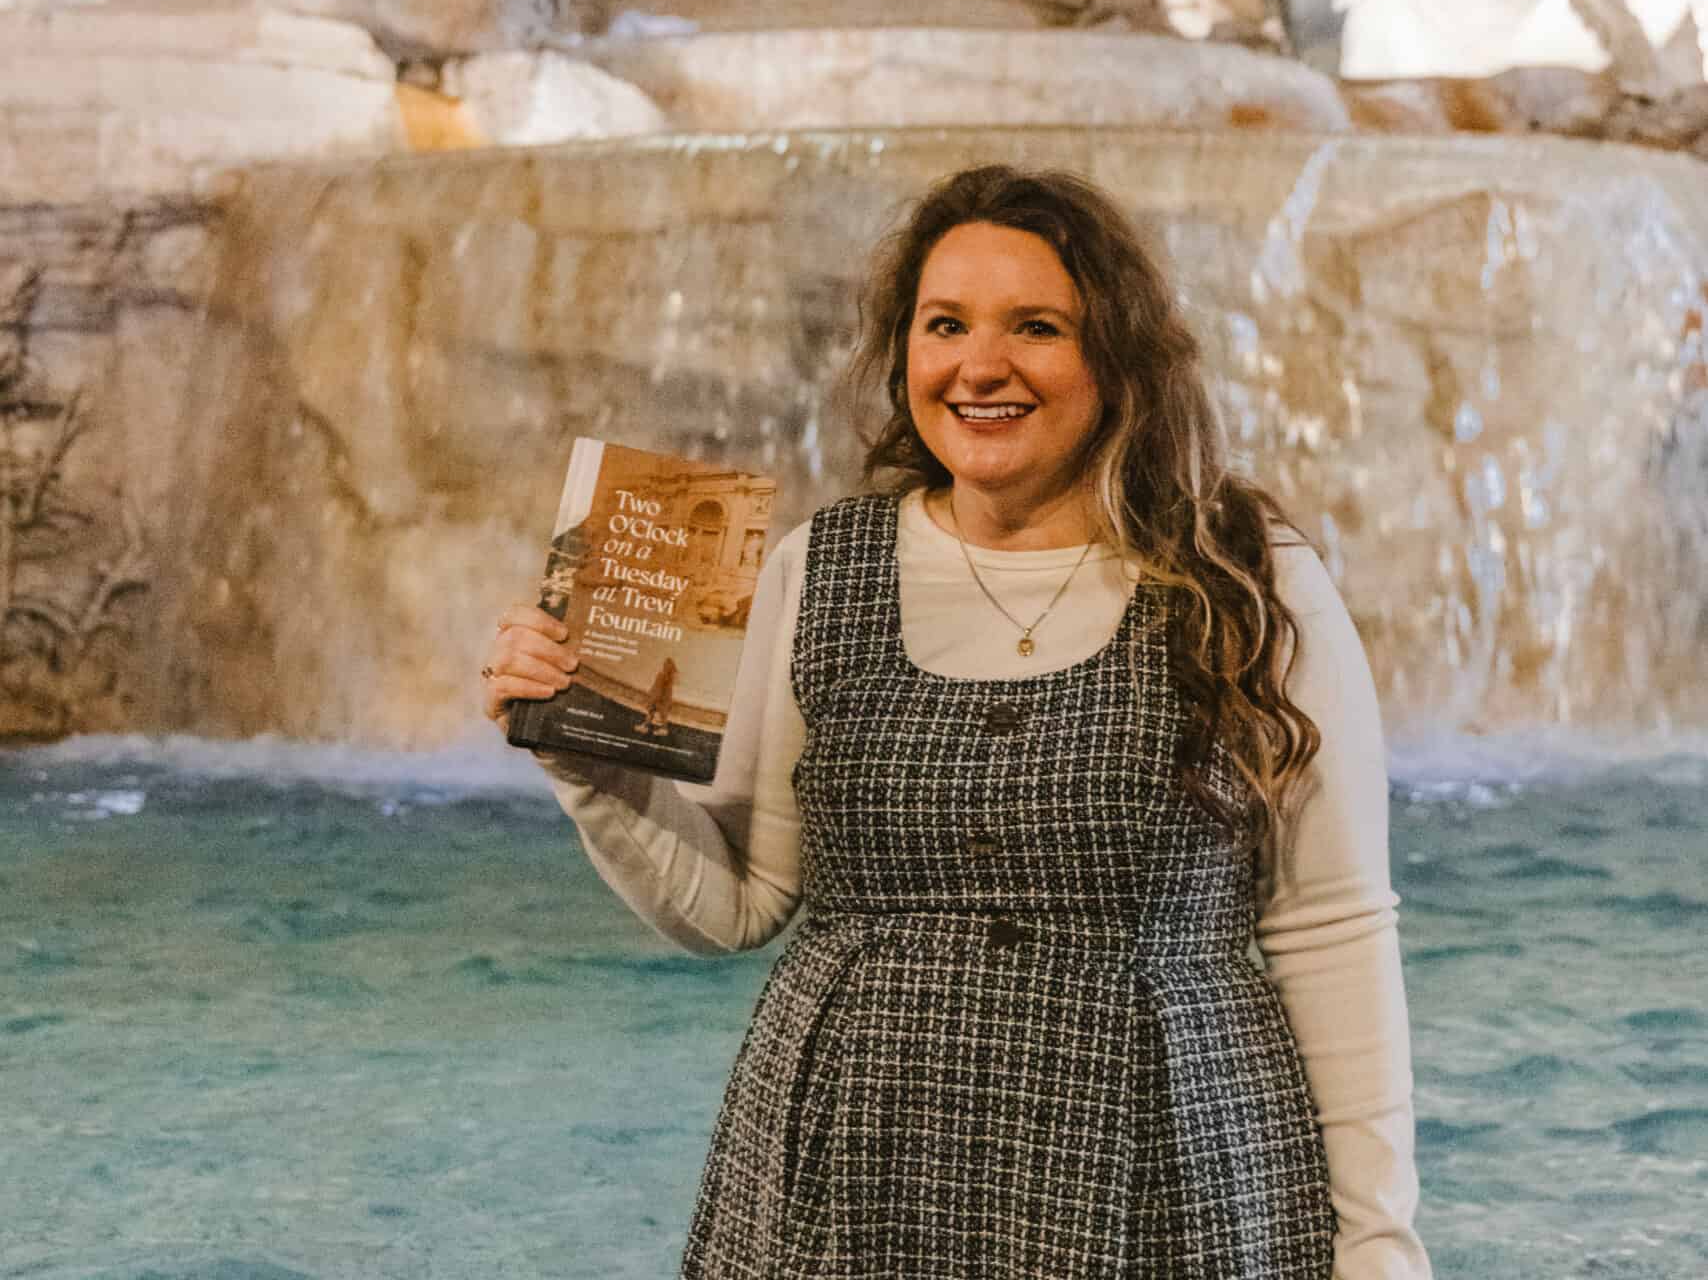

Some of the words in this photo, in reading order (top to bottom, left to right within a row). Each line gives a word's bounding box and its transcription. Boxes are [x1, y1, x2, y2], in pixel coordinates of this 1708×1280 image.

[615, 489, 662, 517] Two
[608, 514, 688, 548] O'Clock
[603, 538, 633, 557] on
[636, 544, 652, 561] a
[600, 557, 689, 597] Tuesday
[592, 585, 617, 603] at
[621, 586, 676, 616] Trevi
[587, 605, 682, 642] Fountain
